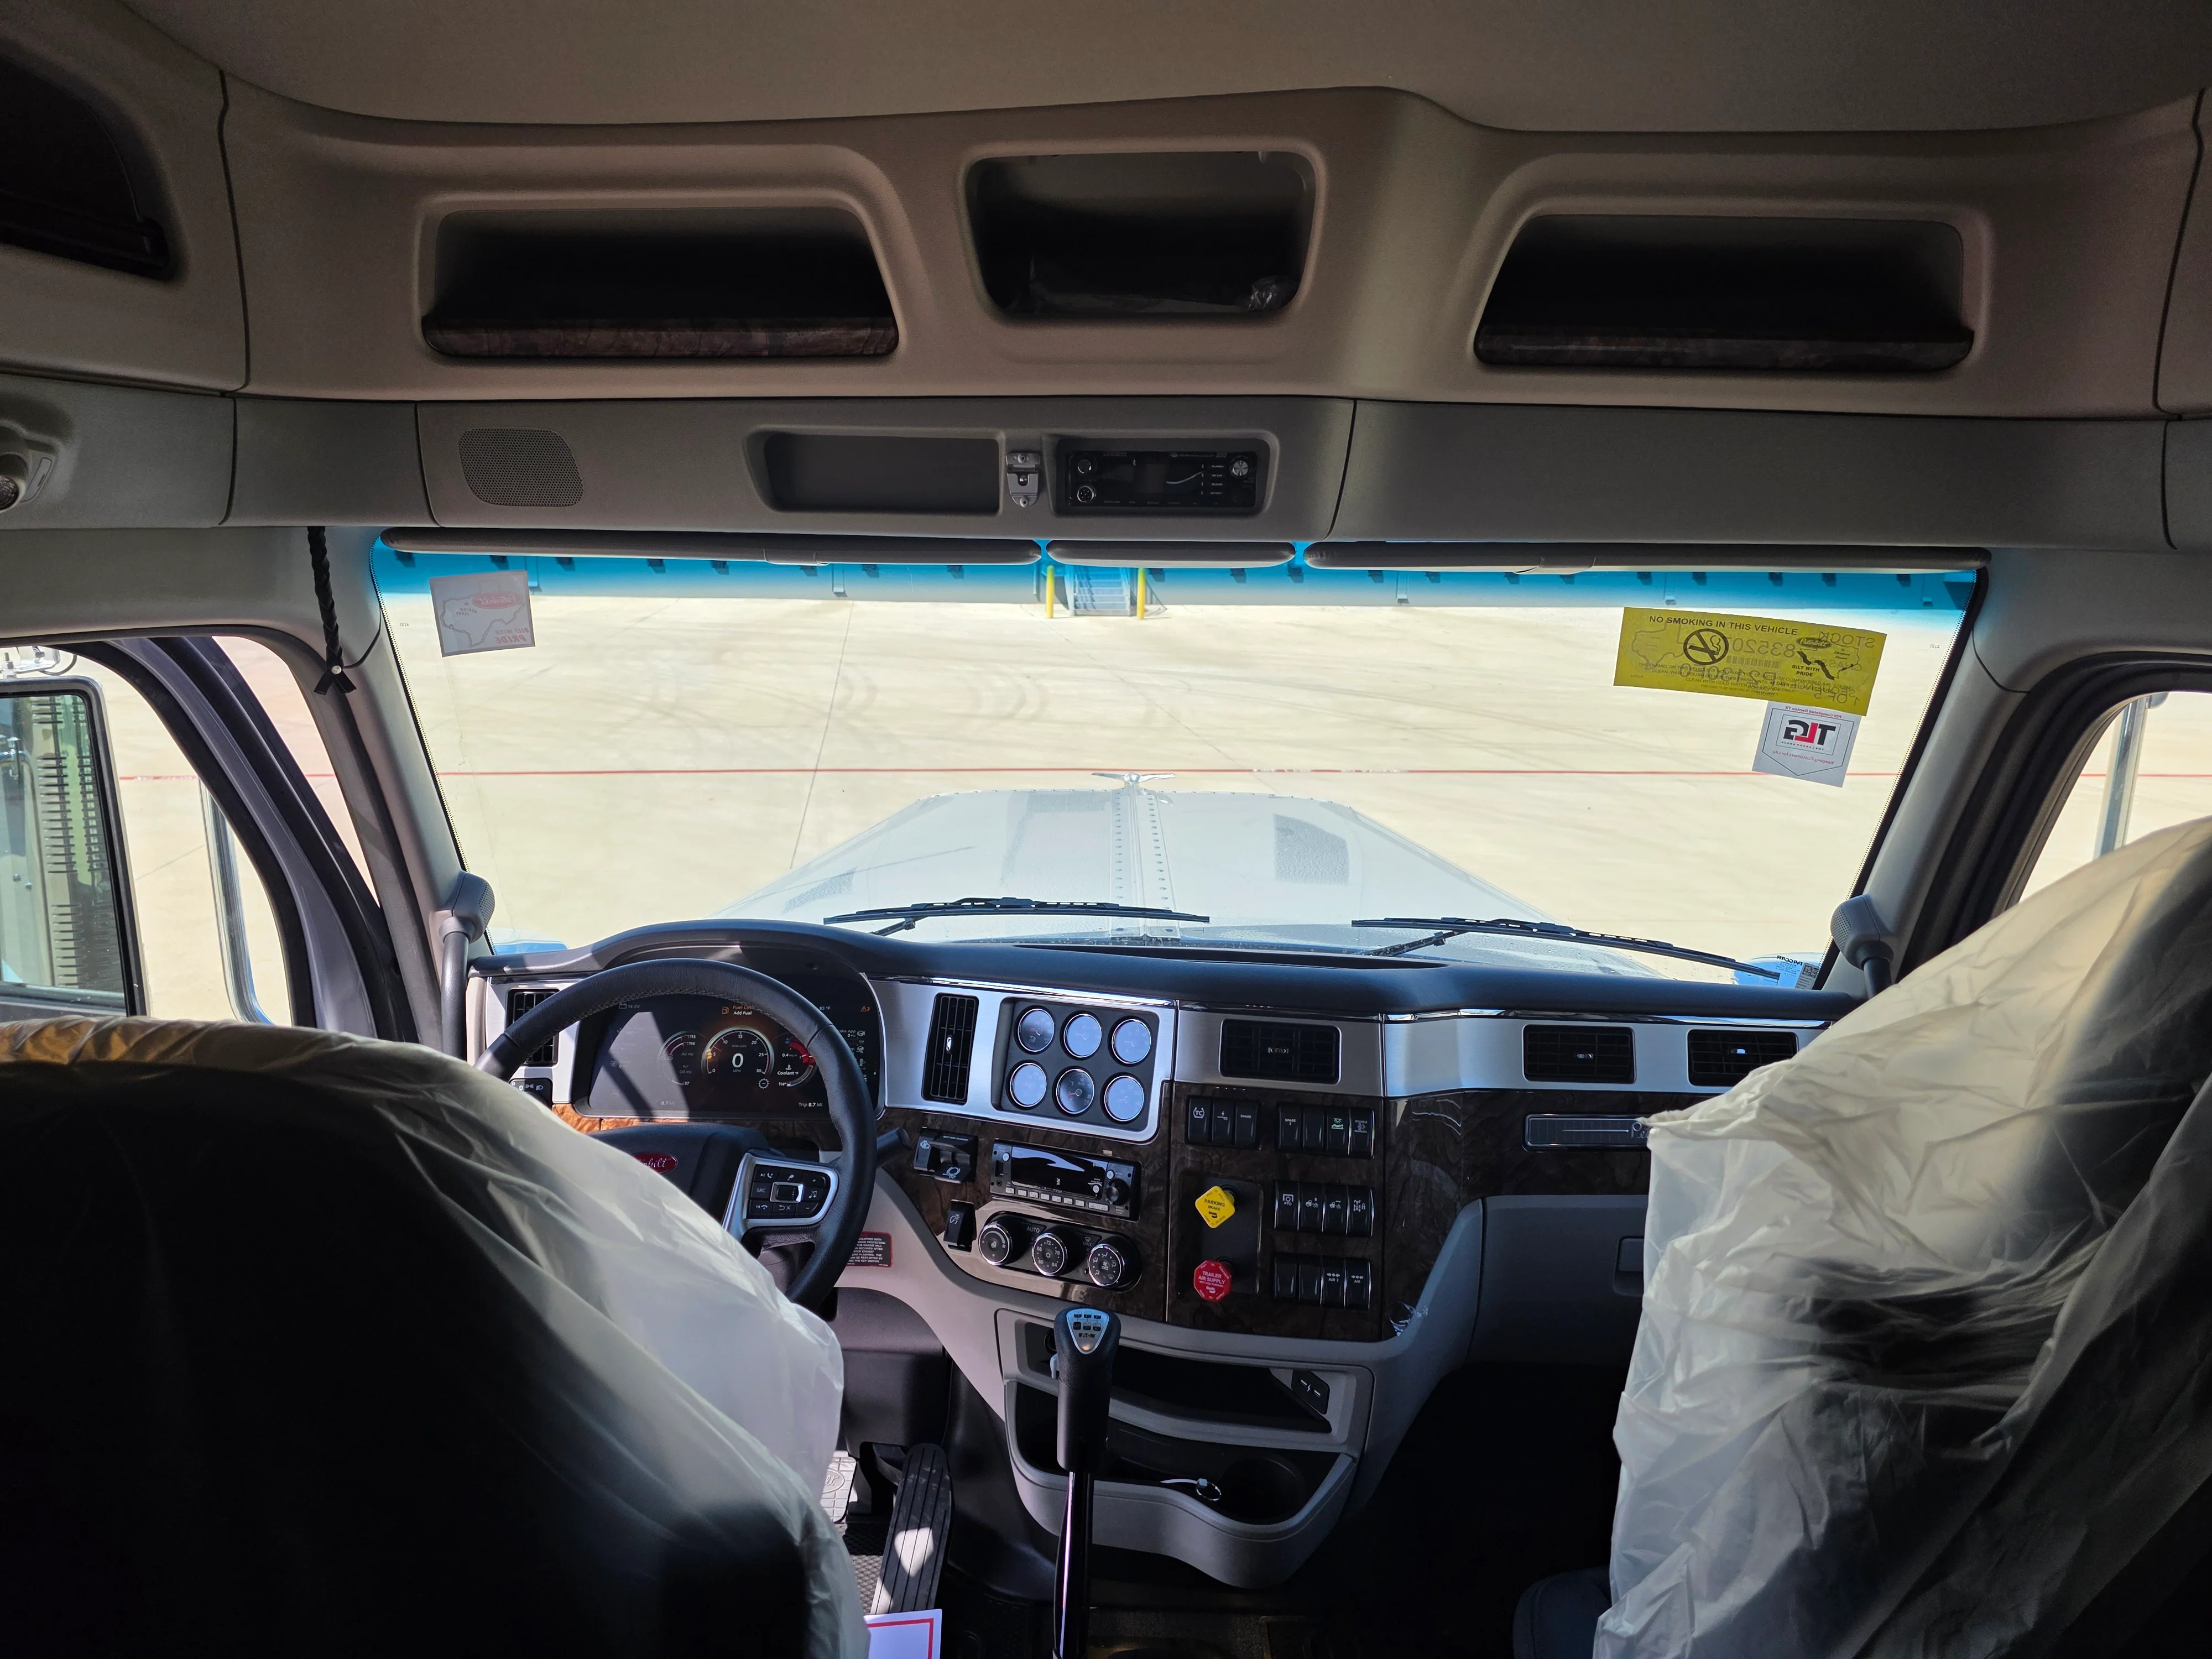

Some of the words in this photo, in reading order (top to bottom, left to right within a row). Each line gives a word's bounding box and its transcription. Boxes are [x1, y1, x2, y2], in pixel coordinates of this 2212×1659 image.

[1666, 617, 1713, 627] SMOKING
[1729, 622, 1751, 630] THIS
[1755, 624, 1798, 635] VEHICLE
[1799, 638, 1828, 647] Peterbilt
[732, 1053, 744, 1068] 0
[1204, 1198, 1225, 1207] PARKING
[1202, 1270, 1222, 1279] TRAILER
